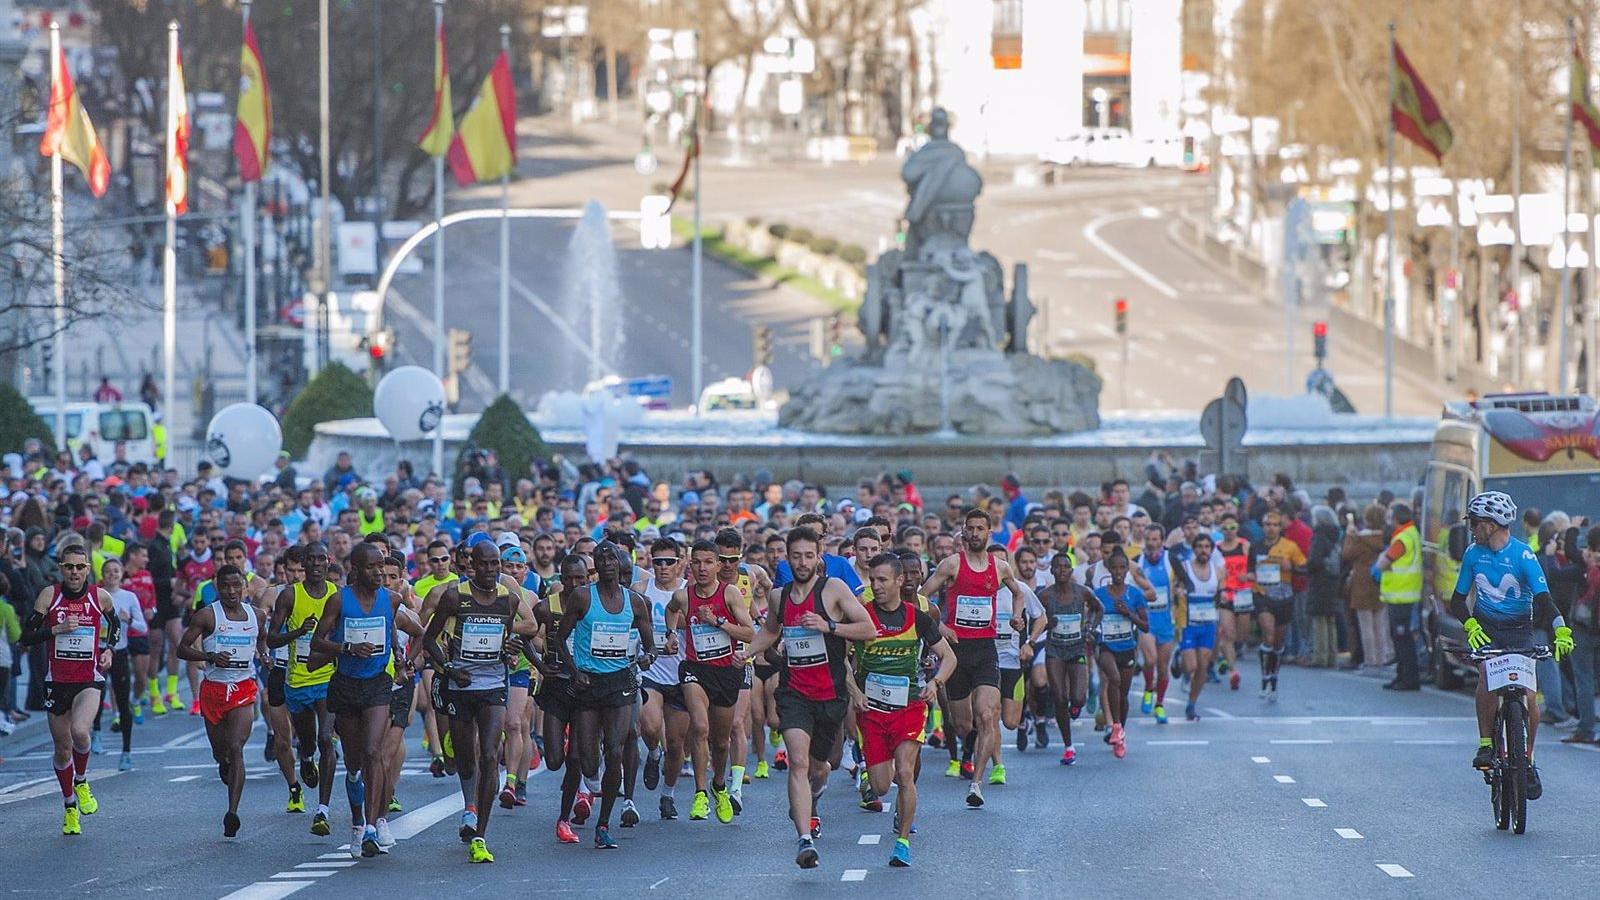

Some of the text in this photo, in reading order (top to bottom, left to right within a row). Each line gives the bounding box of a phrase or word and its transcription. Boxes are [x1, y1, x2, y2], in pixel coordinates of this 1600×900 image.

[473, 616, 502, 624] run-fast
[363, 632, 368, 640] 7
[707, 636, 716, 644] 11
[478, 637, 488, 645] 40
[795, 641, 810, 649] 186
[881, 689, 891, 697] 59
